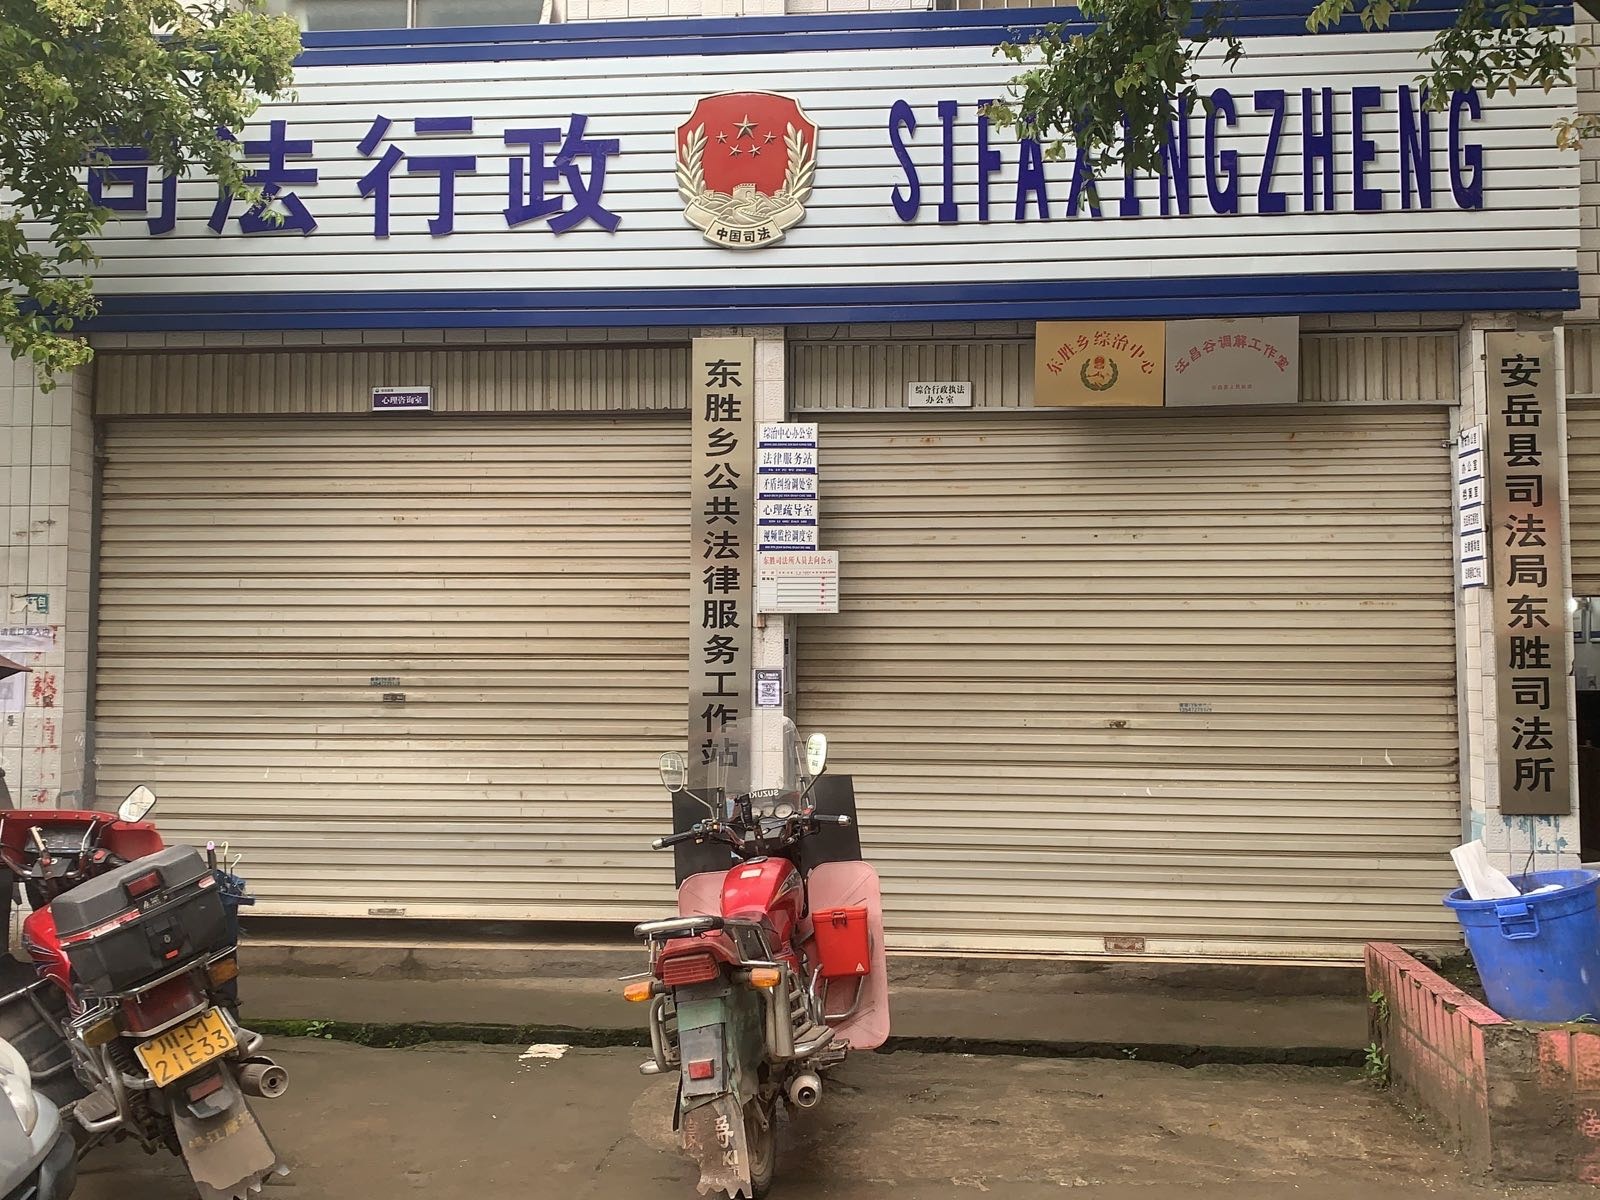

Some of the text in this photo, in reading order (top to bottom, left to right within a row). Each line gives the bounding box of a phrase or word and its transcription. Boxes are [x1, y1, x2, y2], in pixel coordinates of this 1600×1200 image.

[87, 113, 621, 238] 司法行政
[716, 226, 772, 244] 中国司法
[1046, 330, 1155, 376] 东胜乡综治中心
[1174, 334, 1291, 373] 汪昌谷调解工作室
[915, 384, 965, 395] 综合行政执法
[381, 395, 423, 404] 心理咨询室
[925, 395, 954, 404] 办公室
[763, 426, 813, 439] 综治中心办公室
[763, 452, 812, 465] 法律服务站
[763, 503, 813, 516] 心理疏导室
[763, 529, 813, 542] 视频监控调度室
[701, 359, 743, 767] 东胜乡公共法律服务工作站
[1501, 353, 1556, 793] 安岳县司法局东胜司法所
[155, 1029, 229, 1082] 21E33
